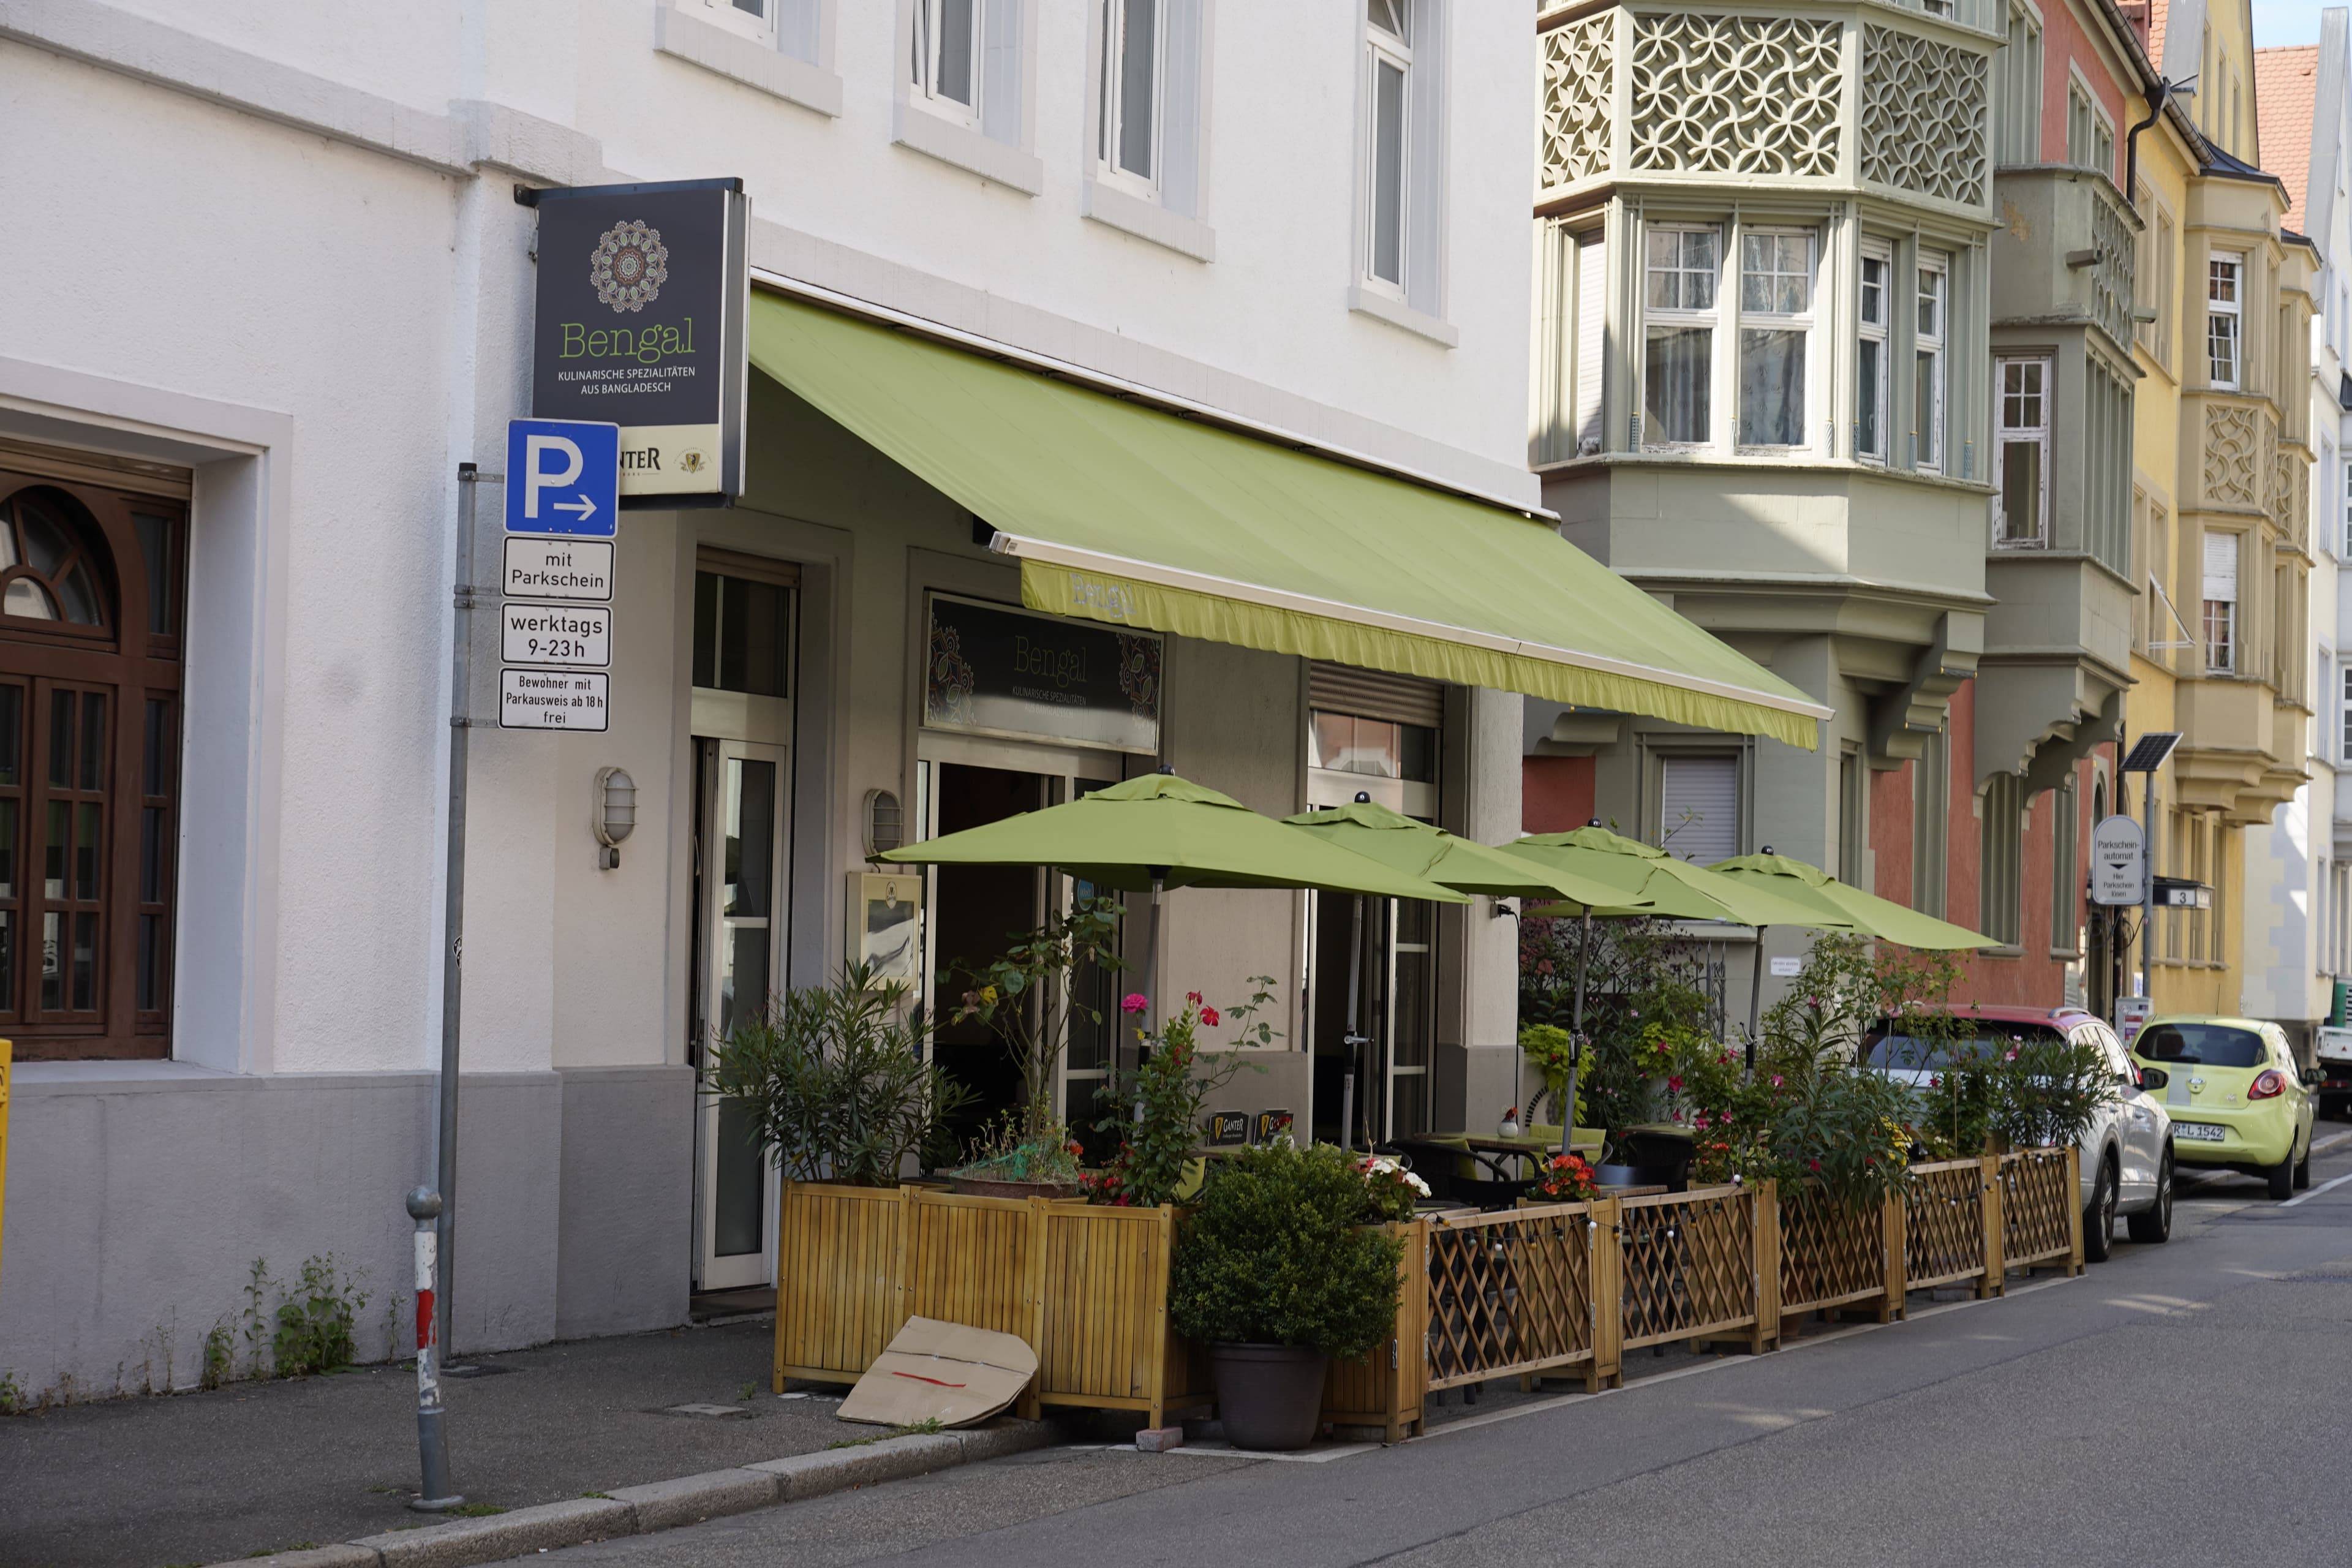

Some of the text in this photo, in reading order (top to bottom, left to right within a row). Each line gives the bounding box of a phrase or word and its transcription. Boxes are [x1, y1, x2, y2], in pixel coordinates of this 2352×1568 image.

[559, 317, 696, 364] Bengal
[558, 366, 695, 381] KULINARISCHE SPEZIALITÄTEN
[581, 382, 671, 395] AUS BANGLADESCH
[619, 447, 661, 470] NTER
[524, 434, 584, 518] P
[545, 552, 572, 567] mit
[512, 569, 604, 589] Parkschein
[511, 614, 603, 638] werktags
[528, 639, 585, 657] 9-23 h
[1014, 635, 1088, 687] Bengal
[519, 676, 592, 691] Bewohner mit
[506, 692, 603, 708] Parkausweis ab 18 h
[1012, 685, 1087, 706] KULINARISCHE SPEZIALITÄTEN
[543, 710, 566, 723] frei
[2098, 840, 2139, 849] Parkschein-
[2103, 851, 2133, 861] automat
[2179, 892, 2187, 904] 3
[1223, 1118, 1243, 1133] GANTER
[2196, 1126, 2223, 1138] 1542
